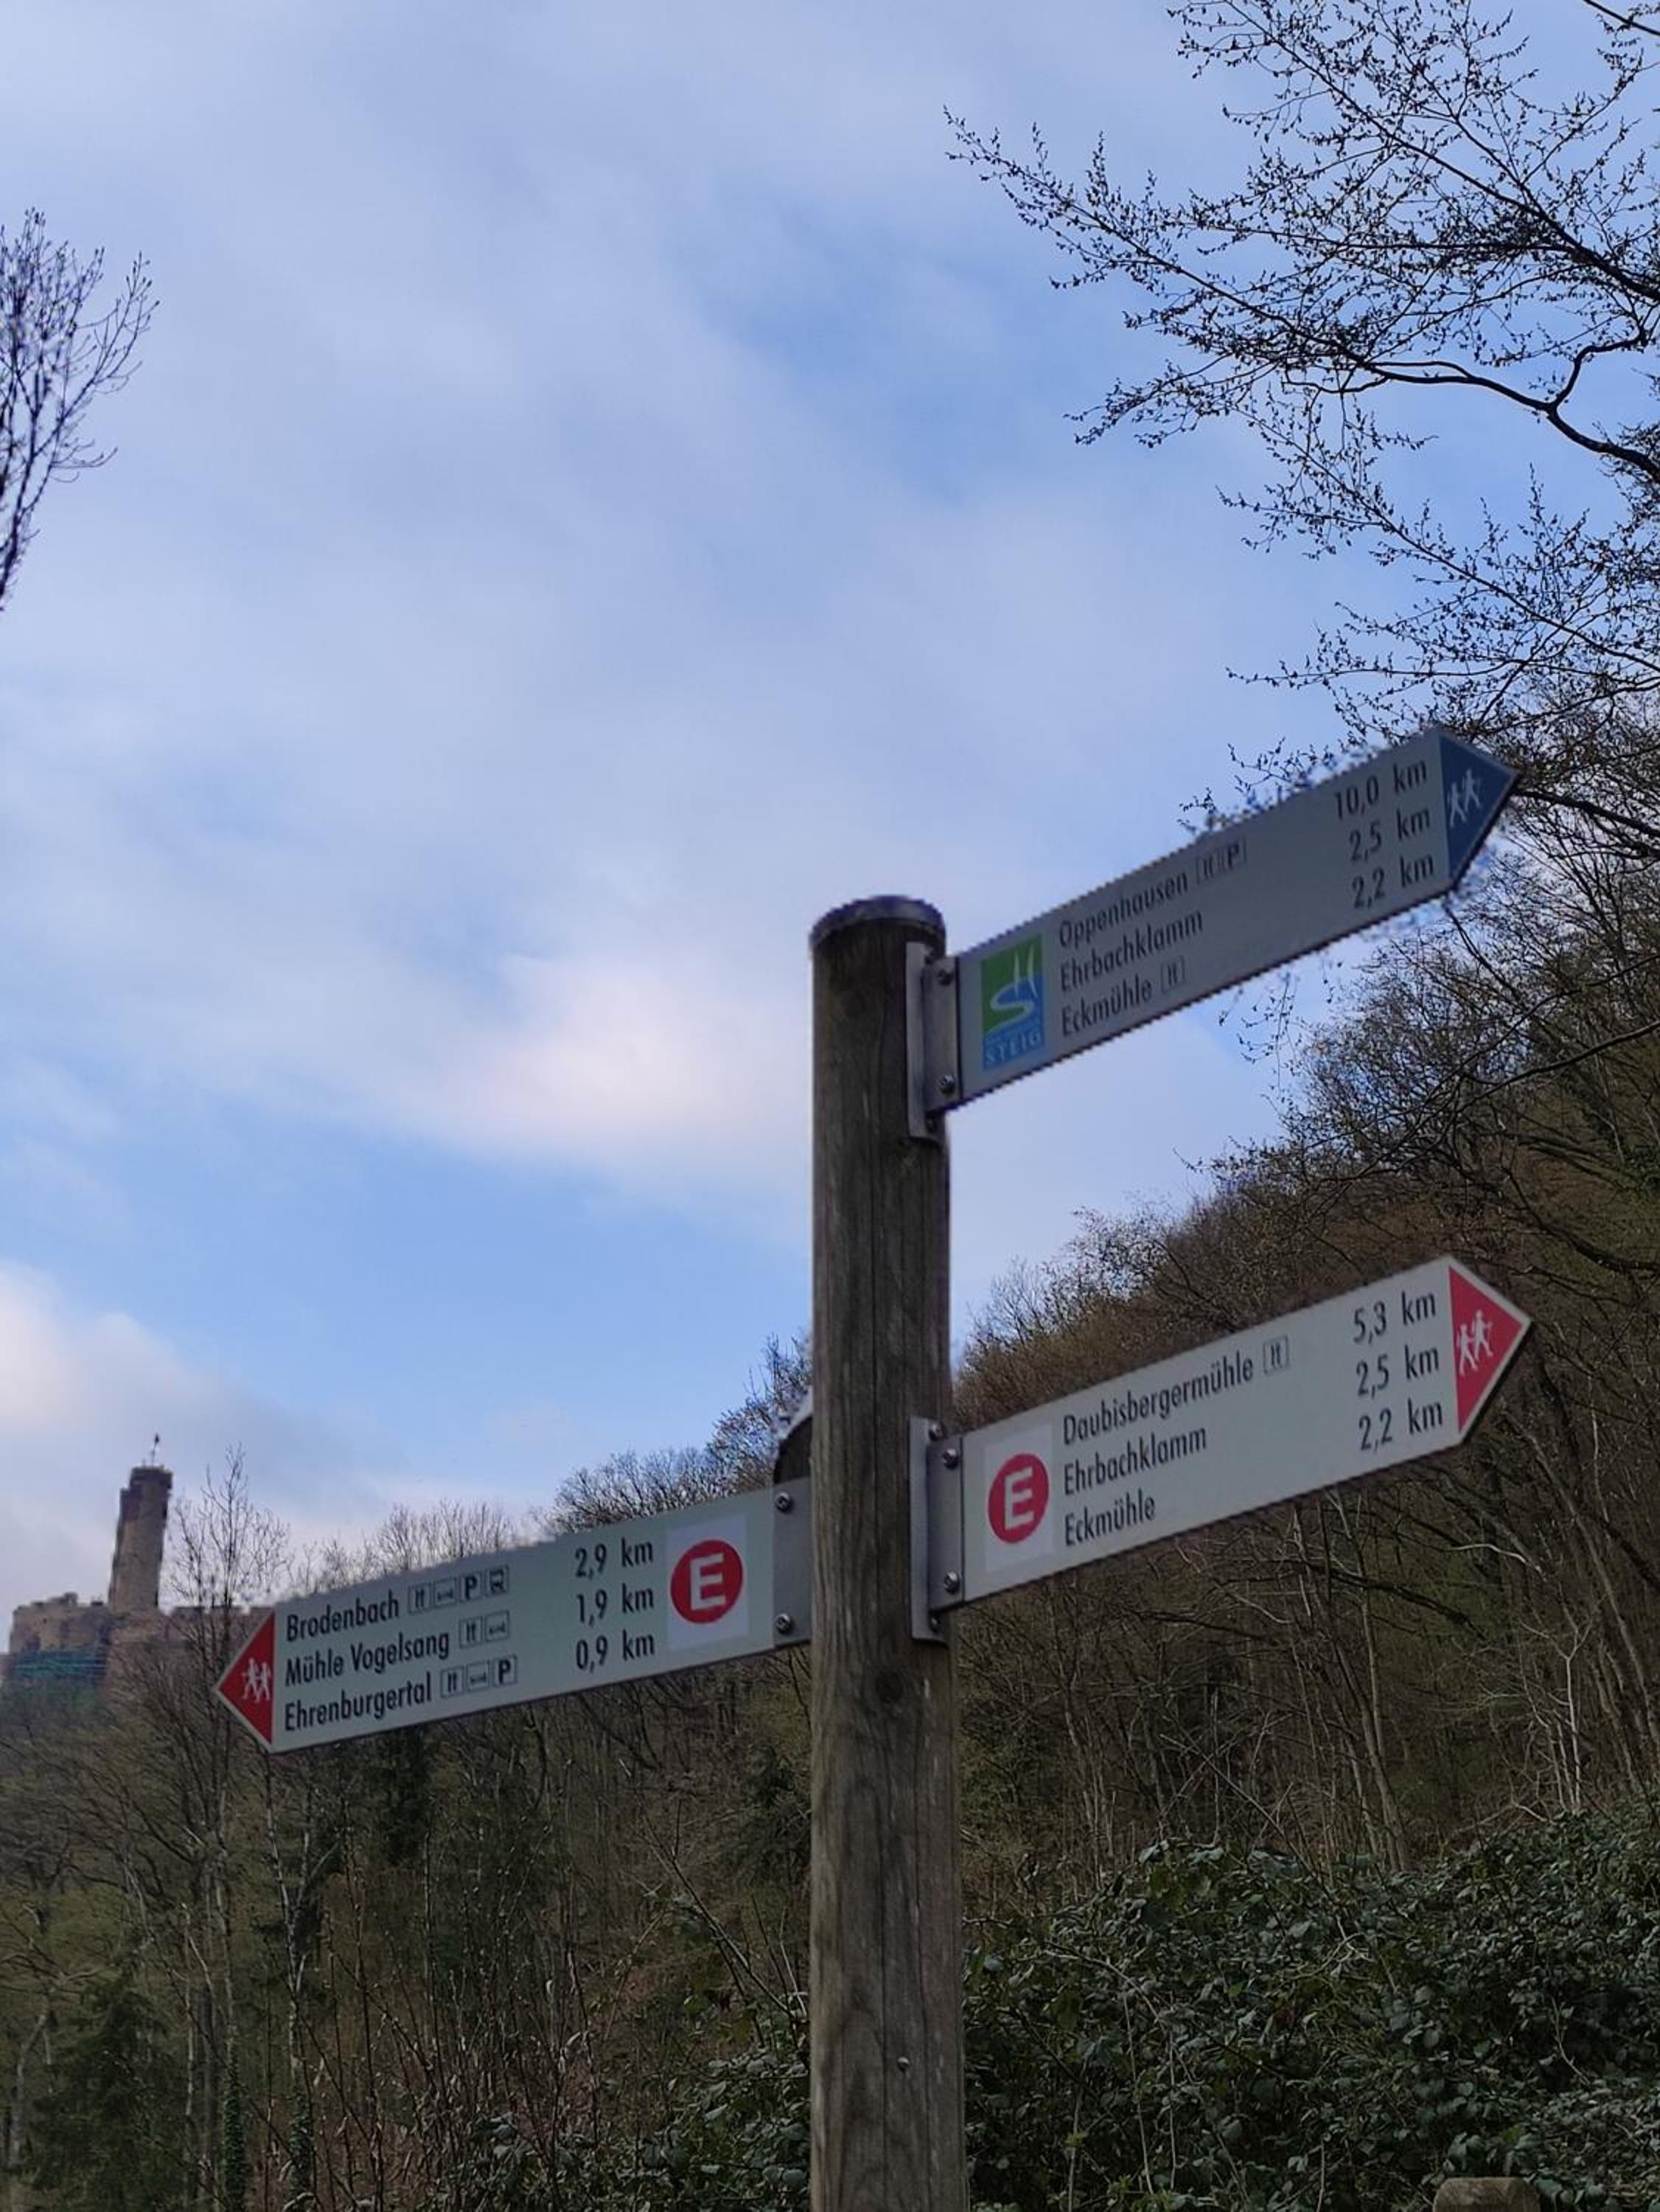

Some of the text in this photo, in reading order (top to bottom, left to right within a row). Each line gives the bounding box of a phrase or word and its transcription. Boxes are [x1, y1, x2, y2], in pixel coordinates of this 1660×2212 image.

[1334, 760, 1428, 821] 10,0 km
[1348, 808, 1431, 862] 2,5 km
[1351, 853, 1434, 909] 2,2 km
[1059, 872, 1189, 948] Oppenhausen
[1060, 910, 1204, 992] Ehrbachklamm
[1061, 974, 1152, 1037] Eckmühle
[1353, 1290, 1437, 1344] 5,3 km
[1062, 1349, 1254, 1447] Daubisbergermühle
[1356, 1344, 1440, 1399] 2,5 km
[1358, 1397, 1443, 1453] 2,2 km
[1063, 1427, 1207, 1497] Ehrbachklamm
[1003, 1467, 1034, 1531] E
[1064, 1487, 1156, 1547] Eckmühle
[574, 1536, 655, 1579] 2,9 km
[689, 1551, 727, 1611] E
[285, 1588, 400, 1643] Brodenbach
[464, 1575, 478, 1600] P
[576, 1582, 655, 1627] 1,9 km
[285, 1631, 450, 1688] Mühle Vogelsang
[498, 1659, 512, 1685] P
[576, 1628, 655, 1674] 0,9 km
[284, 1670, 432, 1732] Ehrenburgertal
